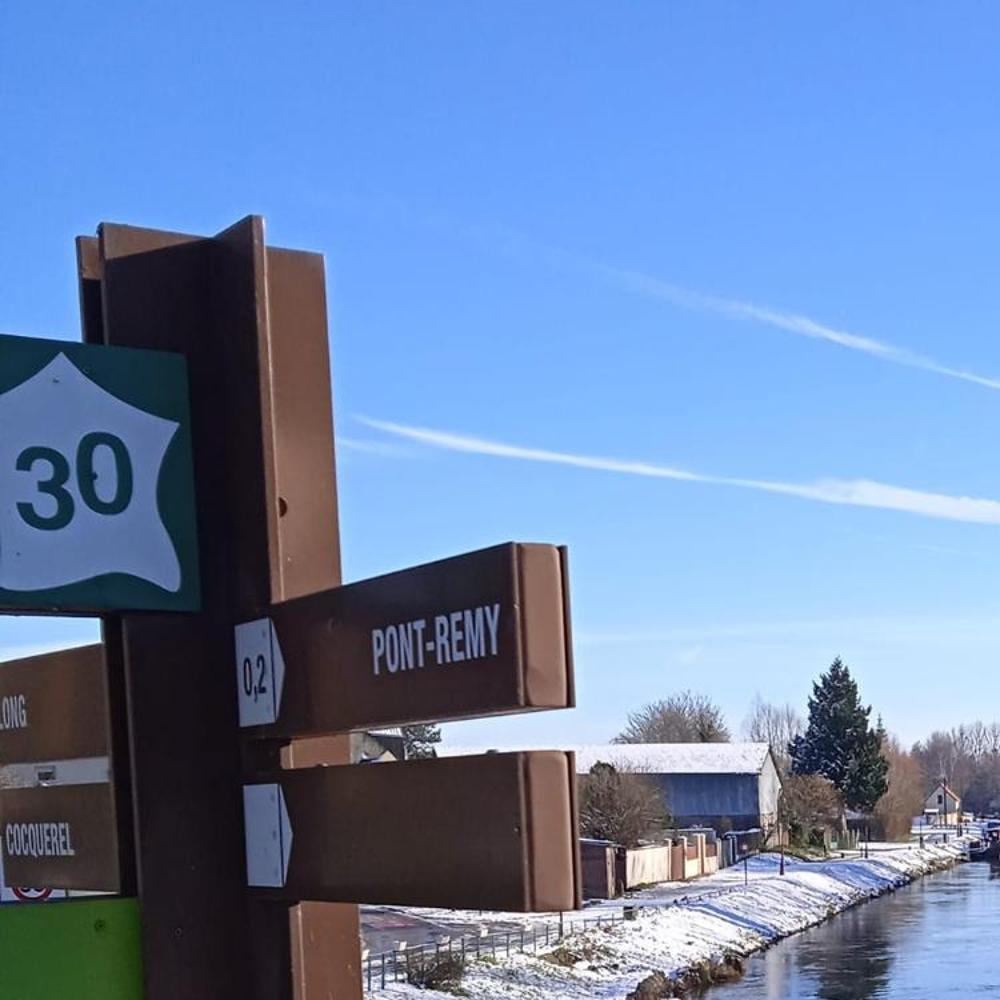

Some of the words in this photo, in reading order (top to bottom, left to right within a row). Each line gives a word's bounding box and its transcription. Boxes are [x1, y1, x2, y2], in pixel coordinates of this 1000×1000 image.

[16, 432, 133, 531] 30
[243, 655, 267, 703] 0,2
[372, 604, 500, 675] PONT-REMY
[6, 822, 75, 856] COCQUEREL
